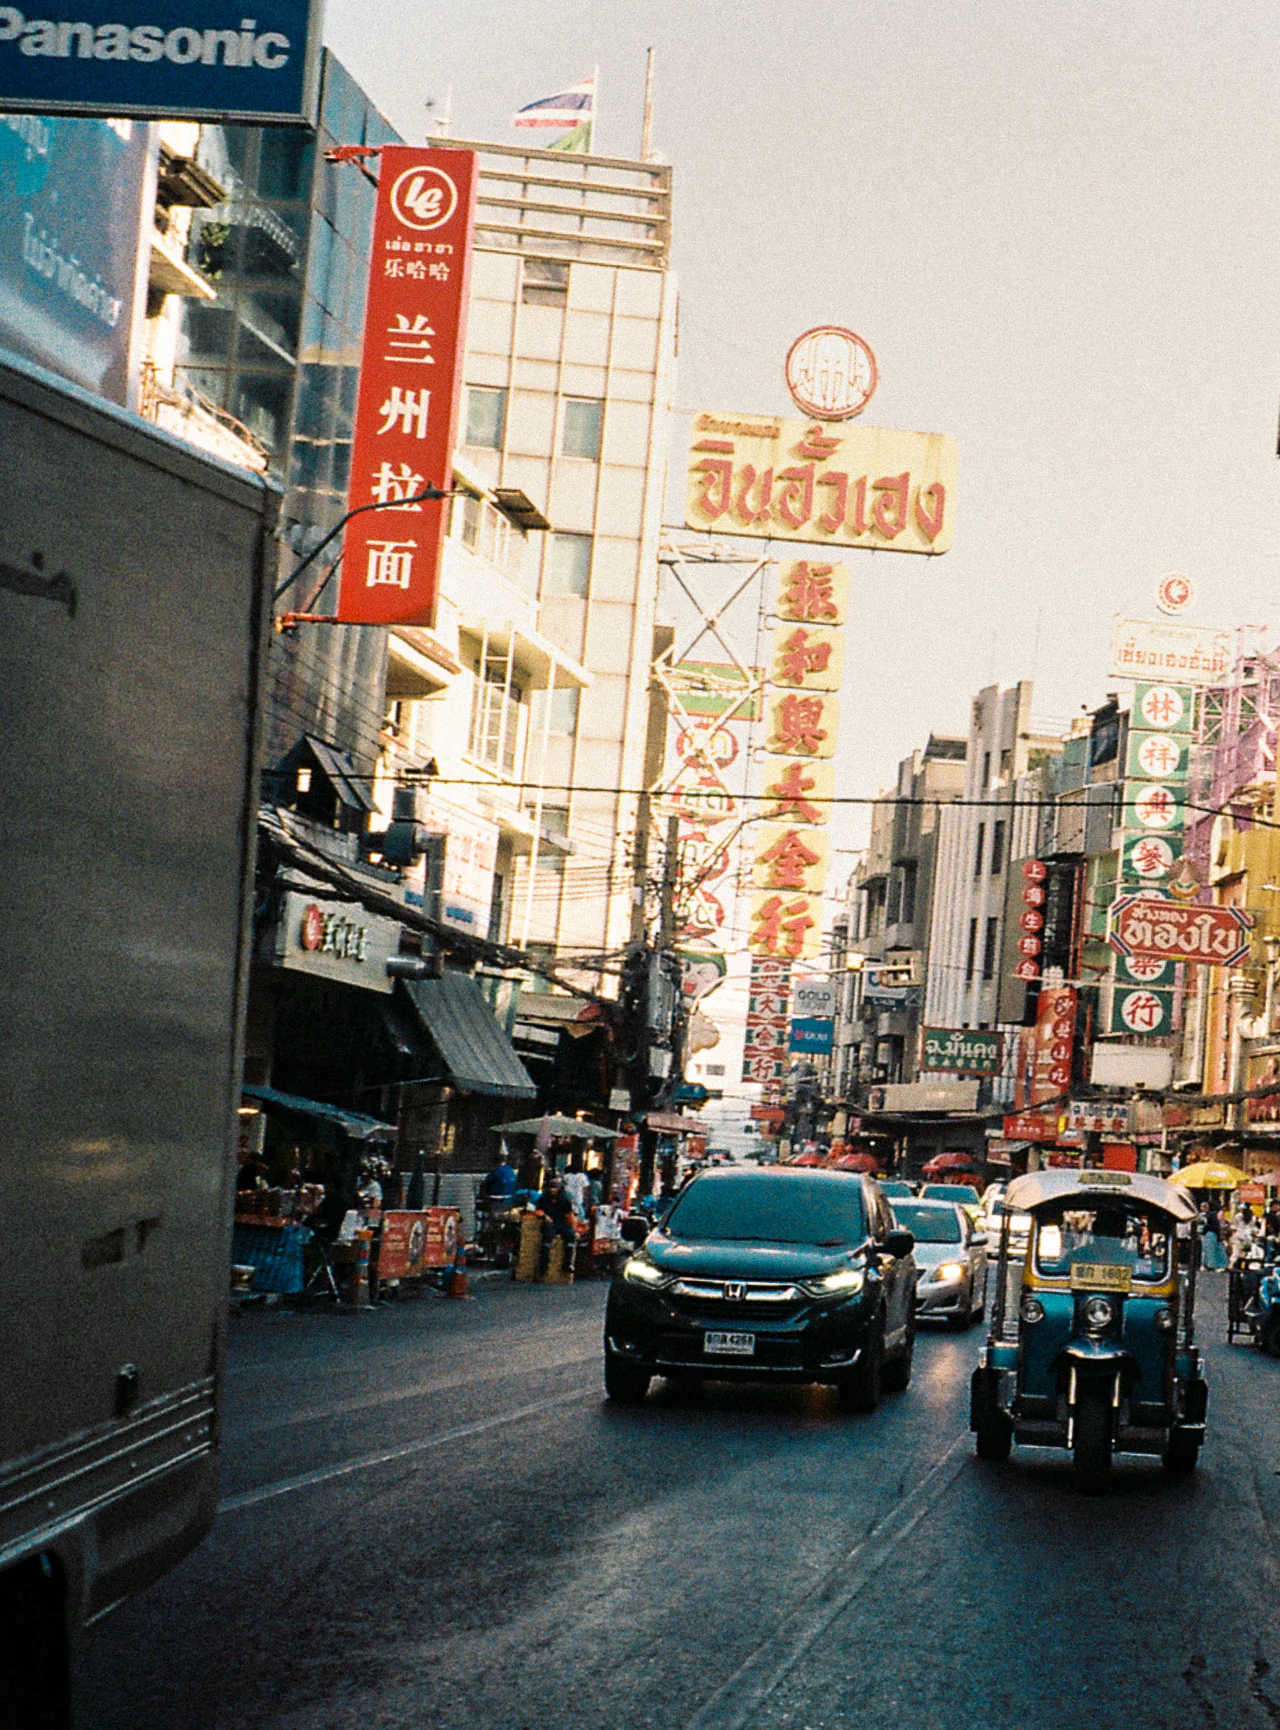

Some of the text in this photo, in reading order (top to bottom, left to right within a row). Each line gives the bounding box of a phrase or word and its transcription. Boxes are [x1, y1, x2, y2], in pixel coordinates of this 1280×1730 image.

[0, 6, 290, 69] Panasonic
[384, 258, 451, 281] 乐哈哈
[364, 313, 437, 590] 兰州拉面
[1123, 914, 1237, 956] ทองใบ
